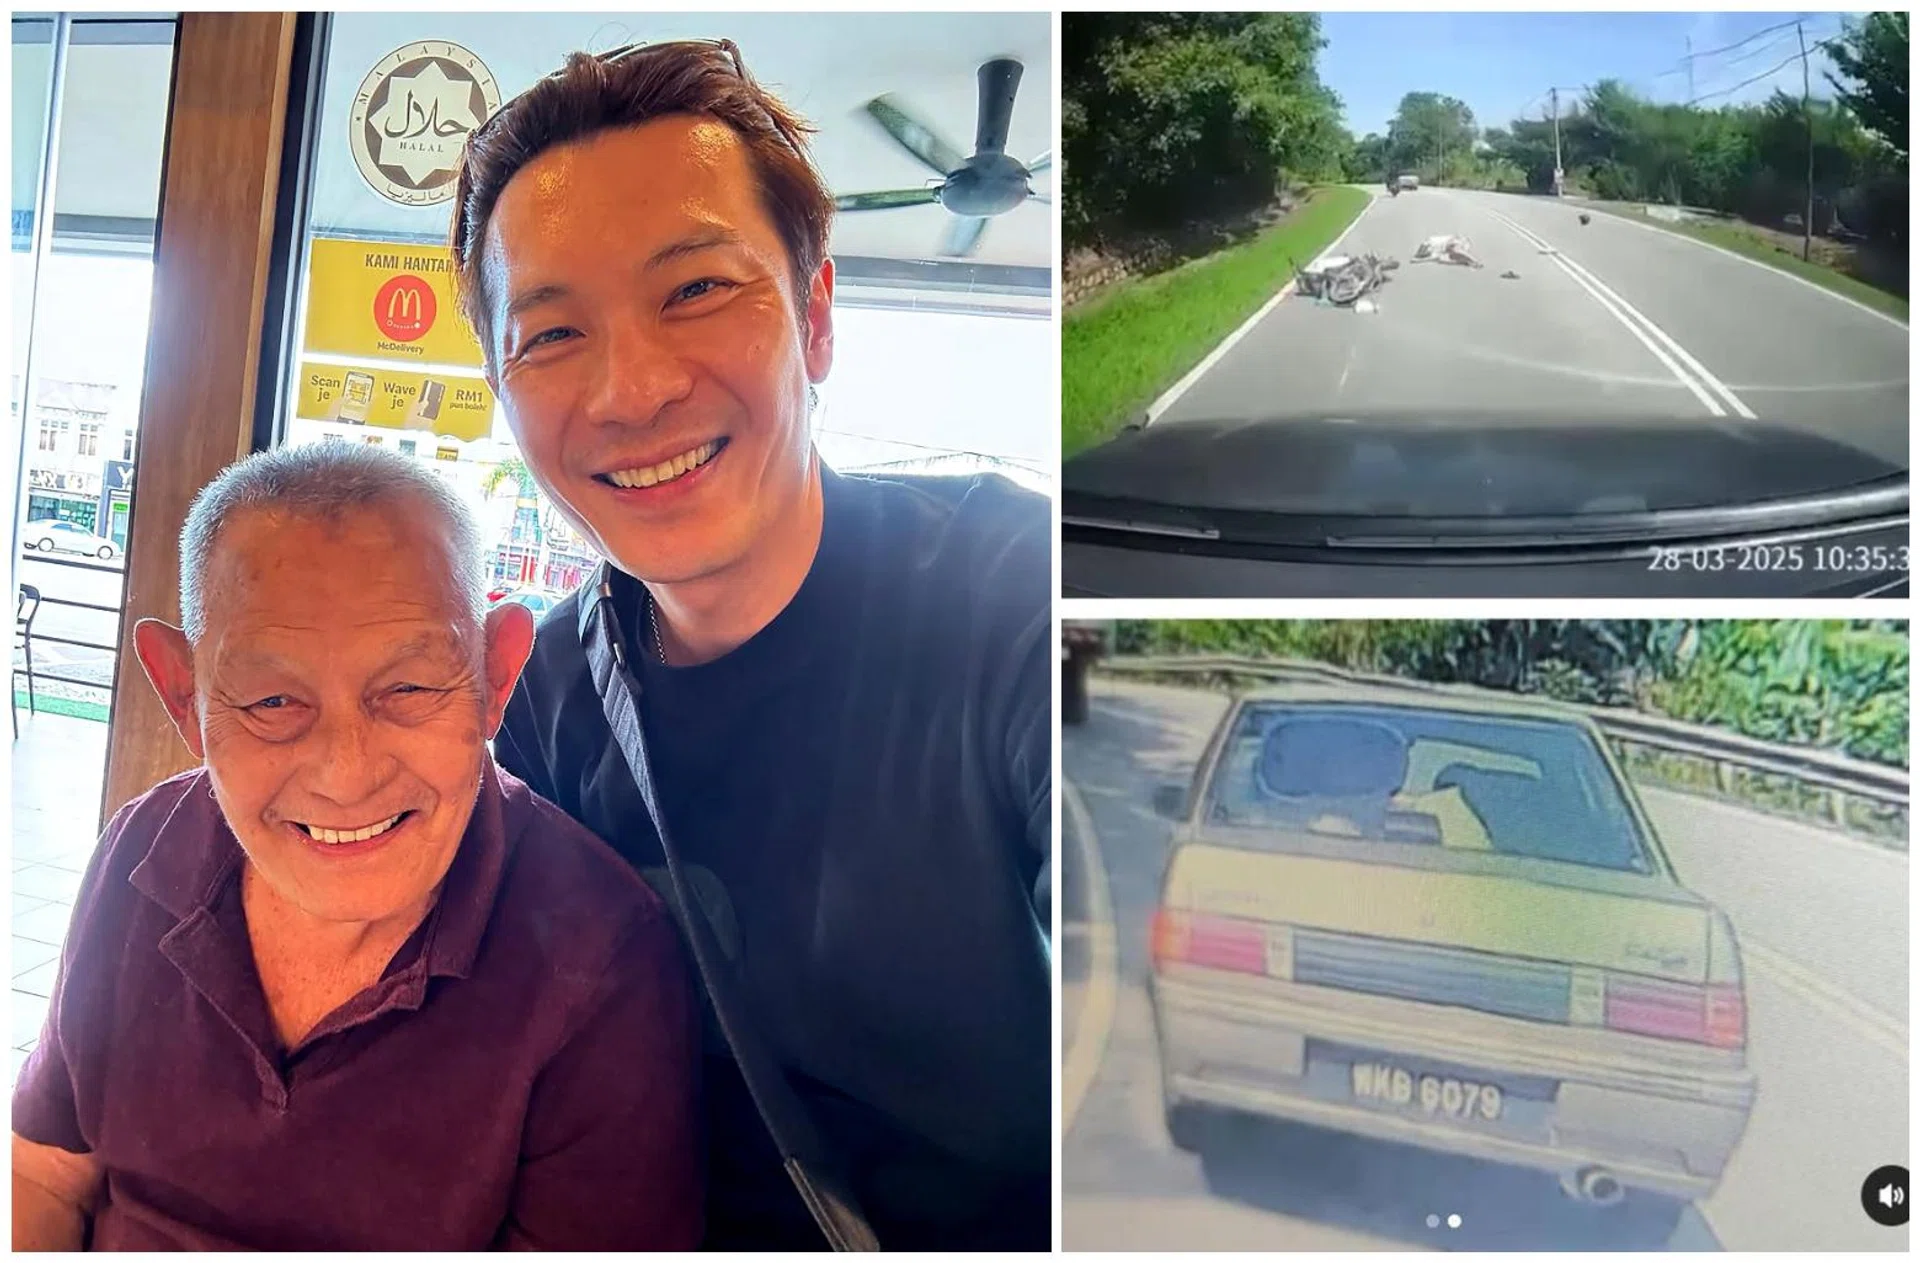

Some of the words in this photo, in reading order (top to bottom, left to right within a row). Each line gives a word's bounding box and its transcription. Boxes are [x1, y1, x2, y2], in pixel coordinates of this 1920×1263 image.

[358, 44, 498, 111] MALAYSIA
[384, 89, 474, 138] حلال
[399, 142, 444, 153] HALAL
[365, 254, 399, 269] KAMI
[377, 342, 424, 354] McDelivery
[311, 375, 340, 388] Scan
[384, 382, 416, 395] Wave
[317, 387, 330, 402] je
[456, 389, 483, 402] RM1
[391, 395, 404, 410] je
[1421, 1075, 1500, 1120] 6079
